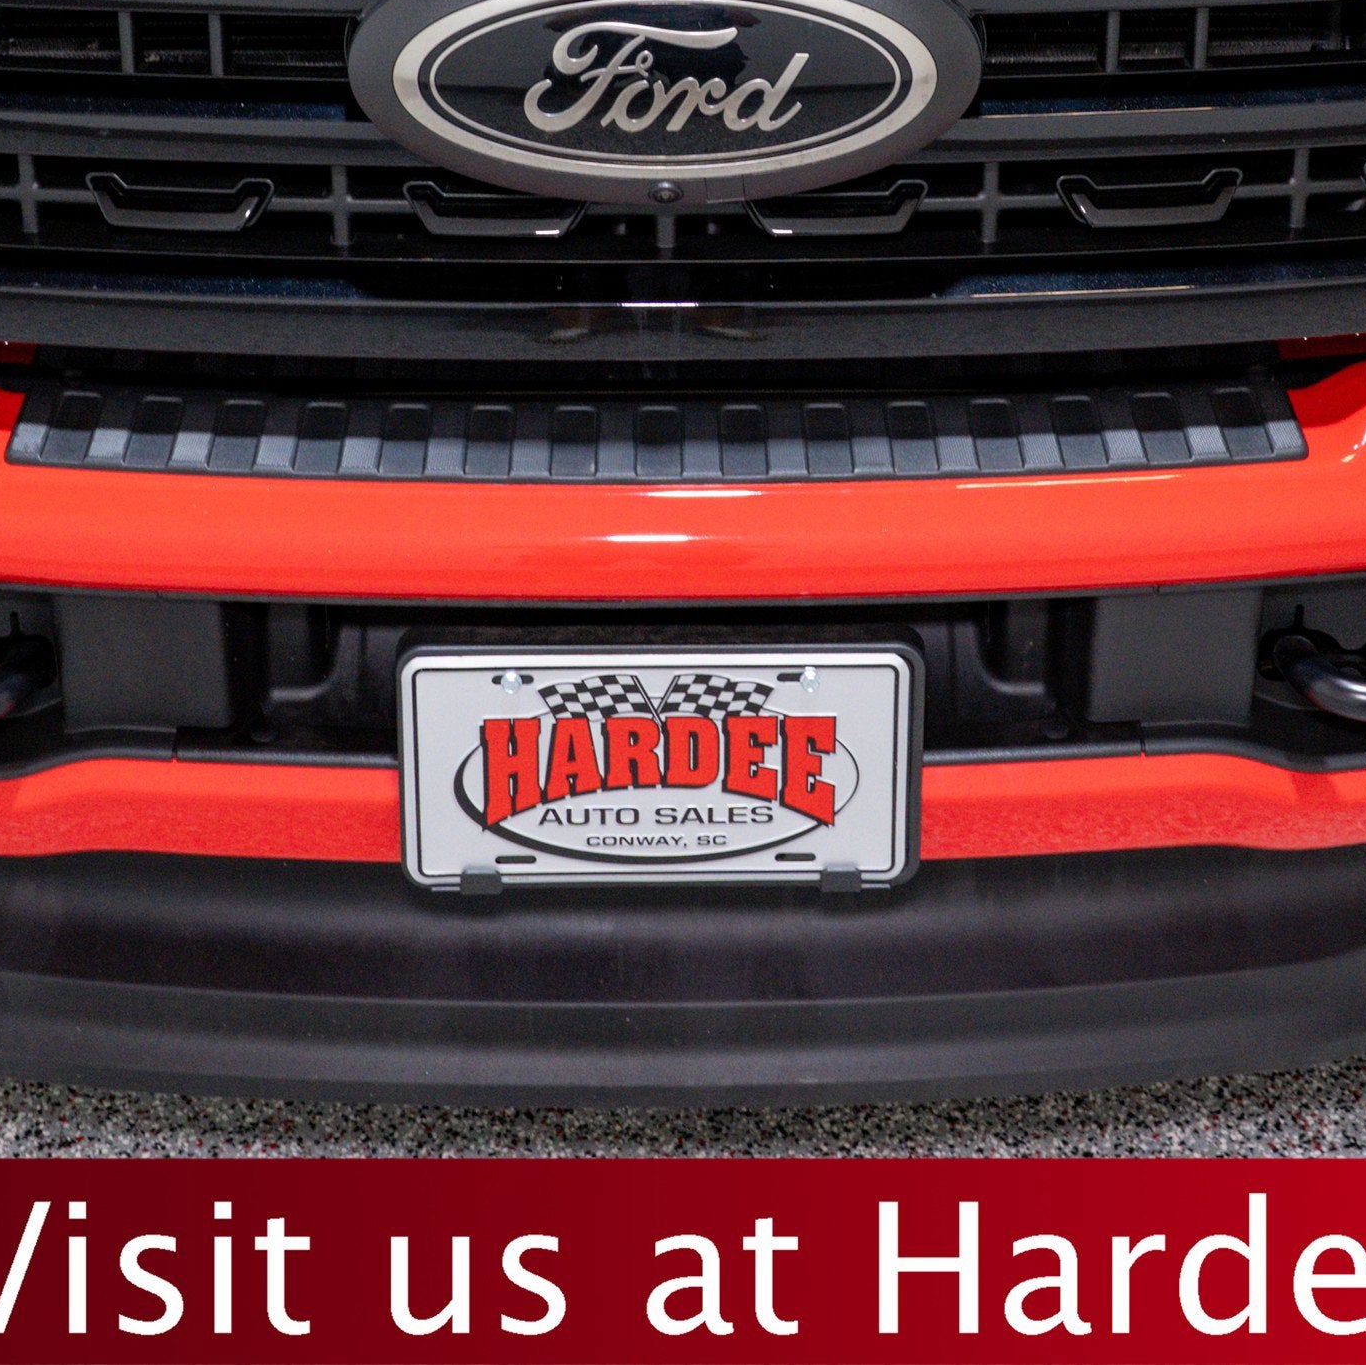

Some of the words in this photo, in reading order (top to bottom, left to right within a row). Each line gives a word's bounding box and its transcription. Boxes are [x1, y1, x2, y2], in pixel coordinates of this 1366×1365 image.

[524, 21, 809, 132] Ford
[479, 715, 837, 831] HARDEE
[538, 805, 641, 826] AUTO
[654, 805, 774, 825] SALES
[585, 835, 689, 848] CONWAY,
[697, 835, 728, 846] SC
